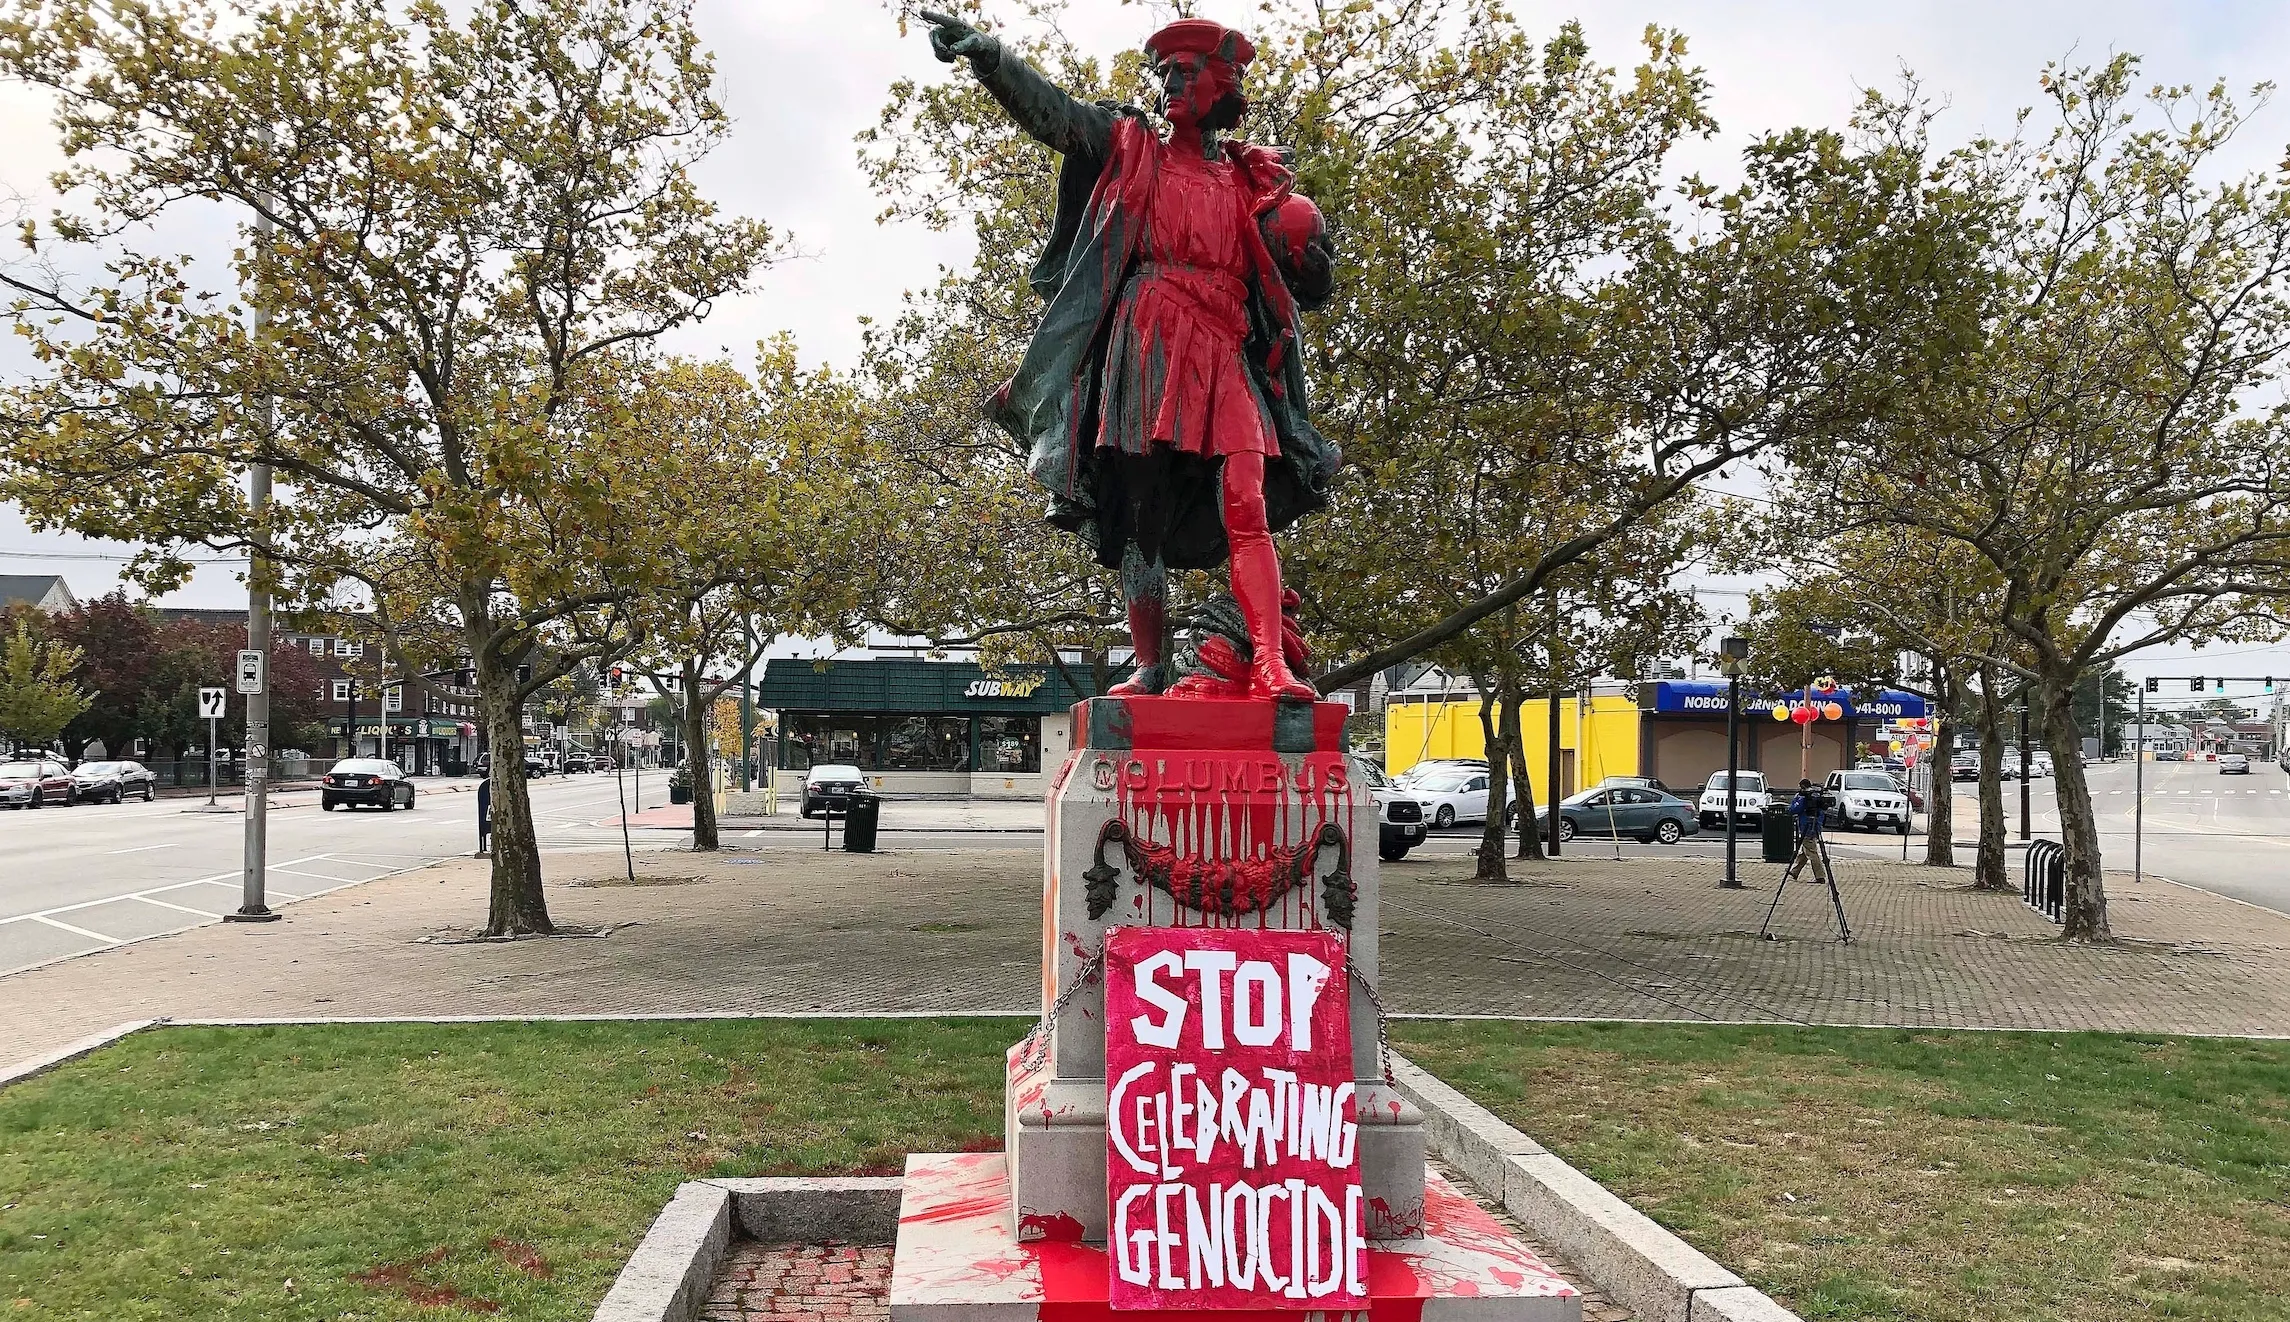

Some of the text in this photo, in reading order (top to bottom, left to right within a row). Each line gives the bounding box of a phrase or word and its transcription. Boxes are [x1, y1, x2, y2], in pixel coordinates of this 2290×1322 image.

[963, 680, 1042, 698] SUBWAY
[1684, 696, 1731, 710] NOBOD
[1744, 699, 1786, 711] URNED
[360, 725, 413, 736] LIQUOS
[1904, 743, 1918, 759] STOP
[1091, 757, 1350, 794] COLUMBUS
[1130, 949, 1331, 1052] STOP
[1108, 1060, 1359, 1181] CELEBRATING
[1114, 1178, 1368, 1299] GENOCIDE
